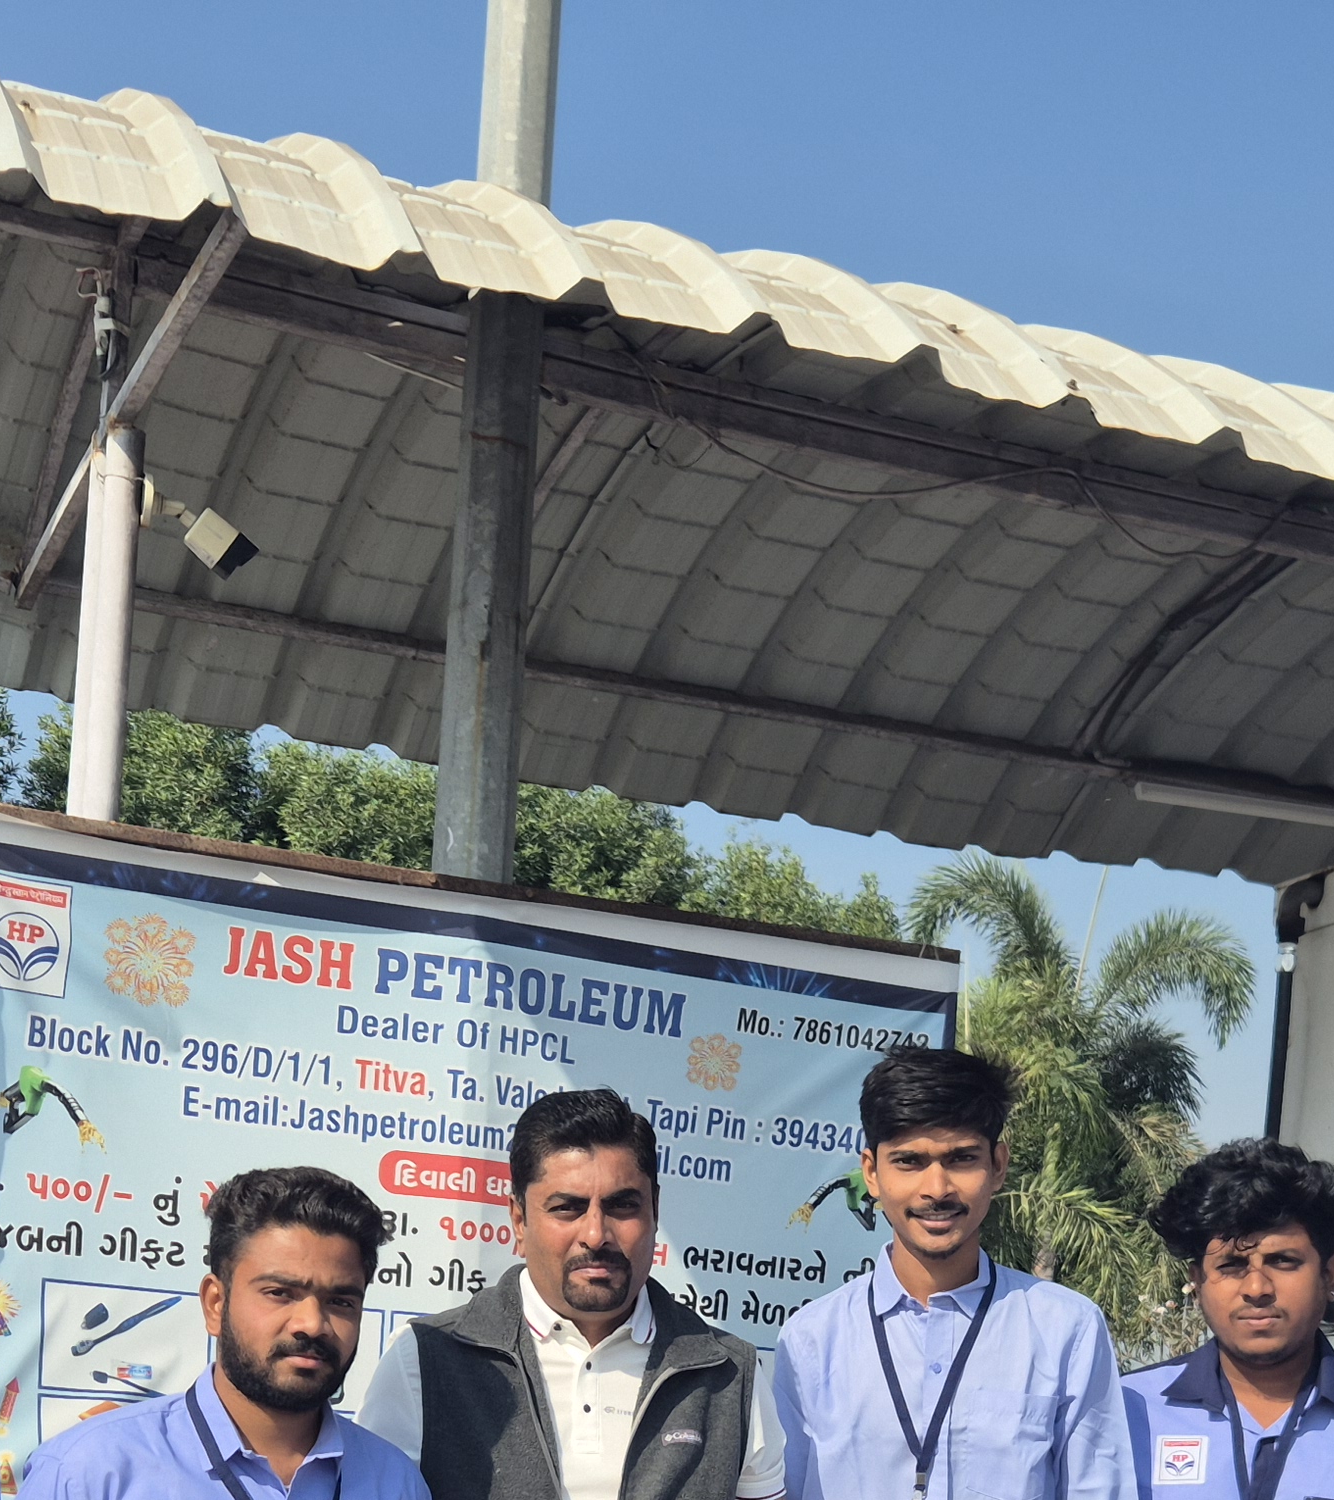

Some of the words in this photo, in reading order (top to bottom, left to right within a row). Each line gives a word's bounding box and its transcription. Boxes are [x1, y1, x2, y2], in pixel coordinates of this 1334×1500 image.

[7, 920, 45, 944] HP
[223, 926, 355, 990] JASH
[375, 947, 687, 1039] PETROLEUM
[336, 1005, 445, 1045] Dealer
[456, 1018, 490, 1050] Of
[499, 1026, 576, 1065] HPCL
[27, 1014, 111, 1058] Block
[121, 1028, 169, 1067] No.
[181, 1038, 343, 1091] 296/D/1/1,
[355, 1058, 435, 1102] Titva,
[447, 1068, 485, 1103] Ta.
[647, 1098, 698, 1139] Tapi
[706, 1107, 747, 1142] Pin
[393, 1159, 477, 1194] દિવાલી
[683, 1245, 827, 1284] ભરાવનારને
[1172, 1454, 1189, 1463] HP
